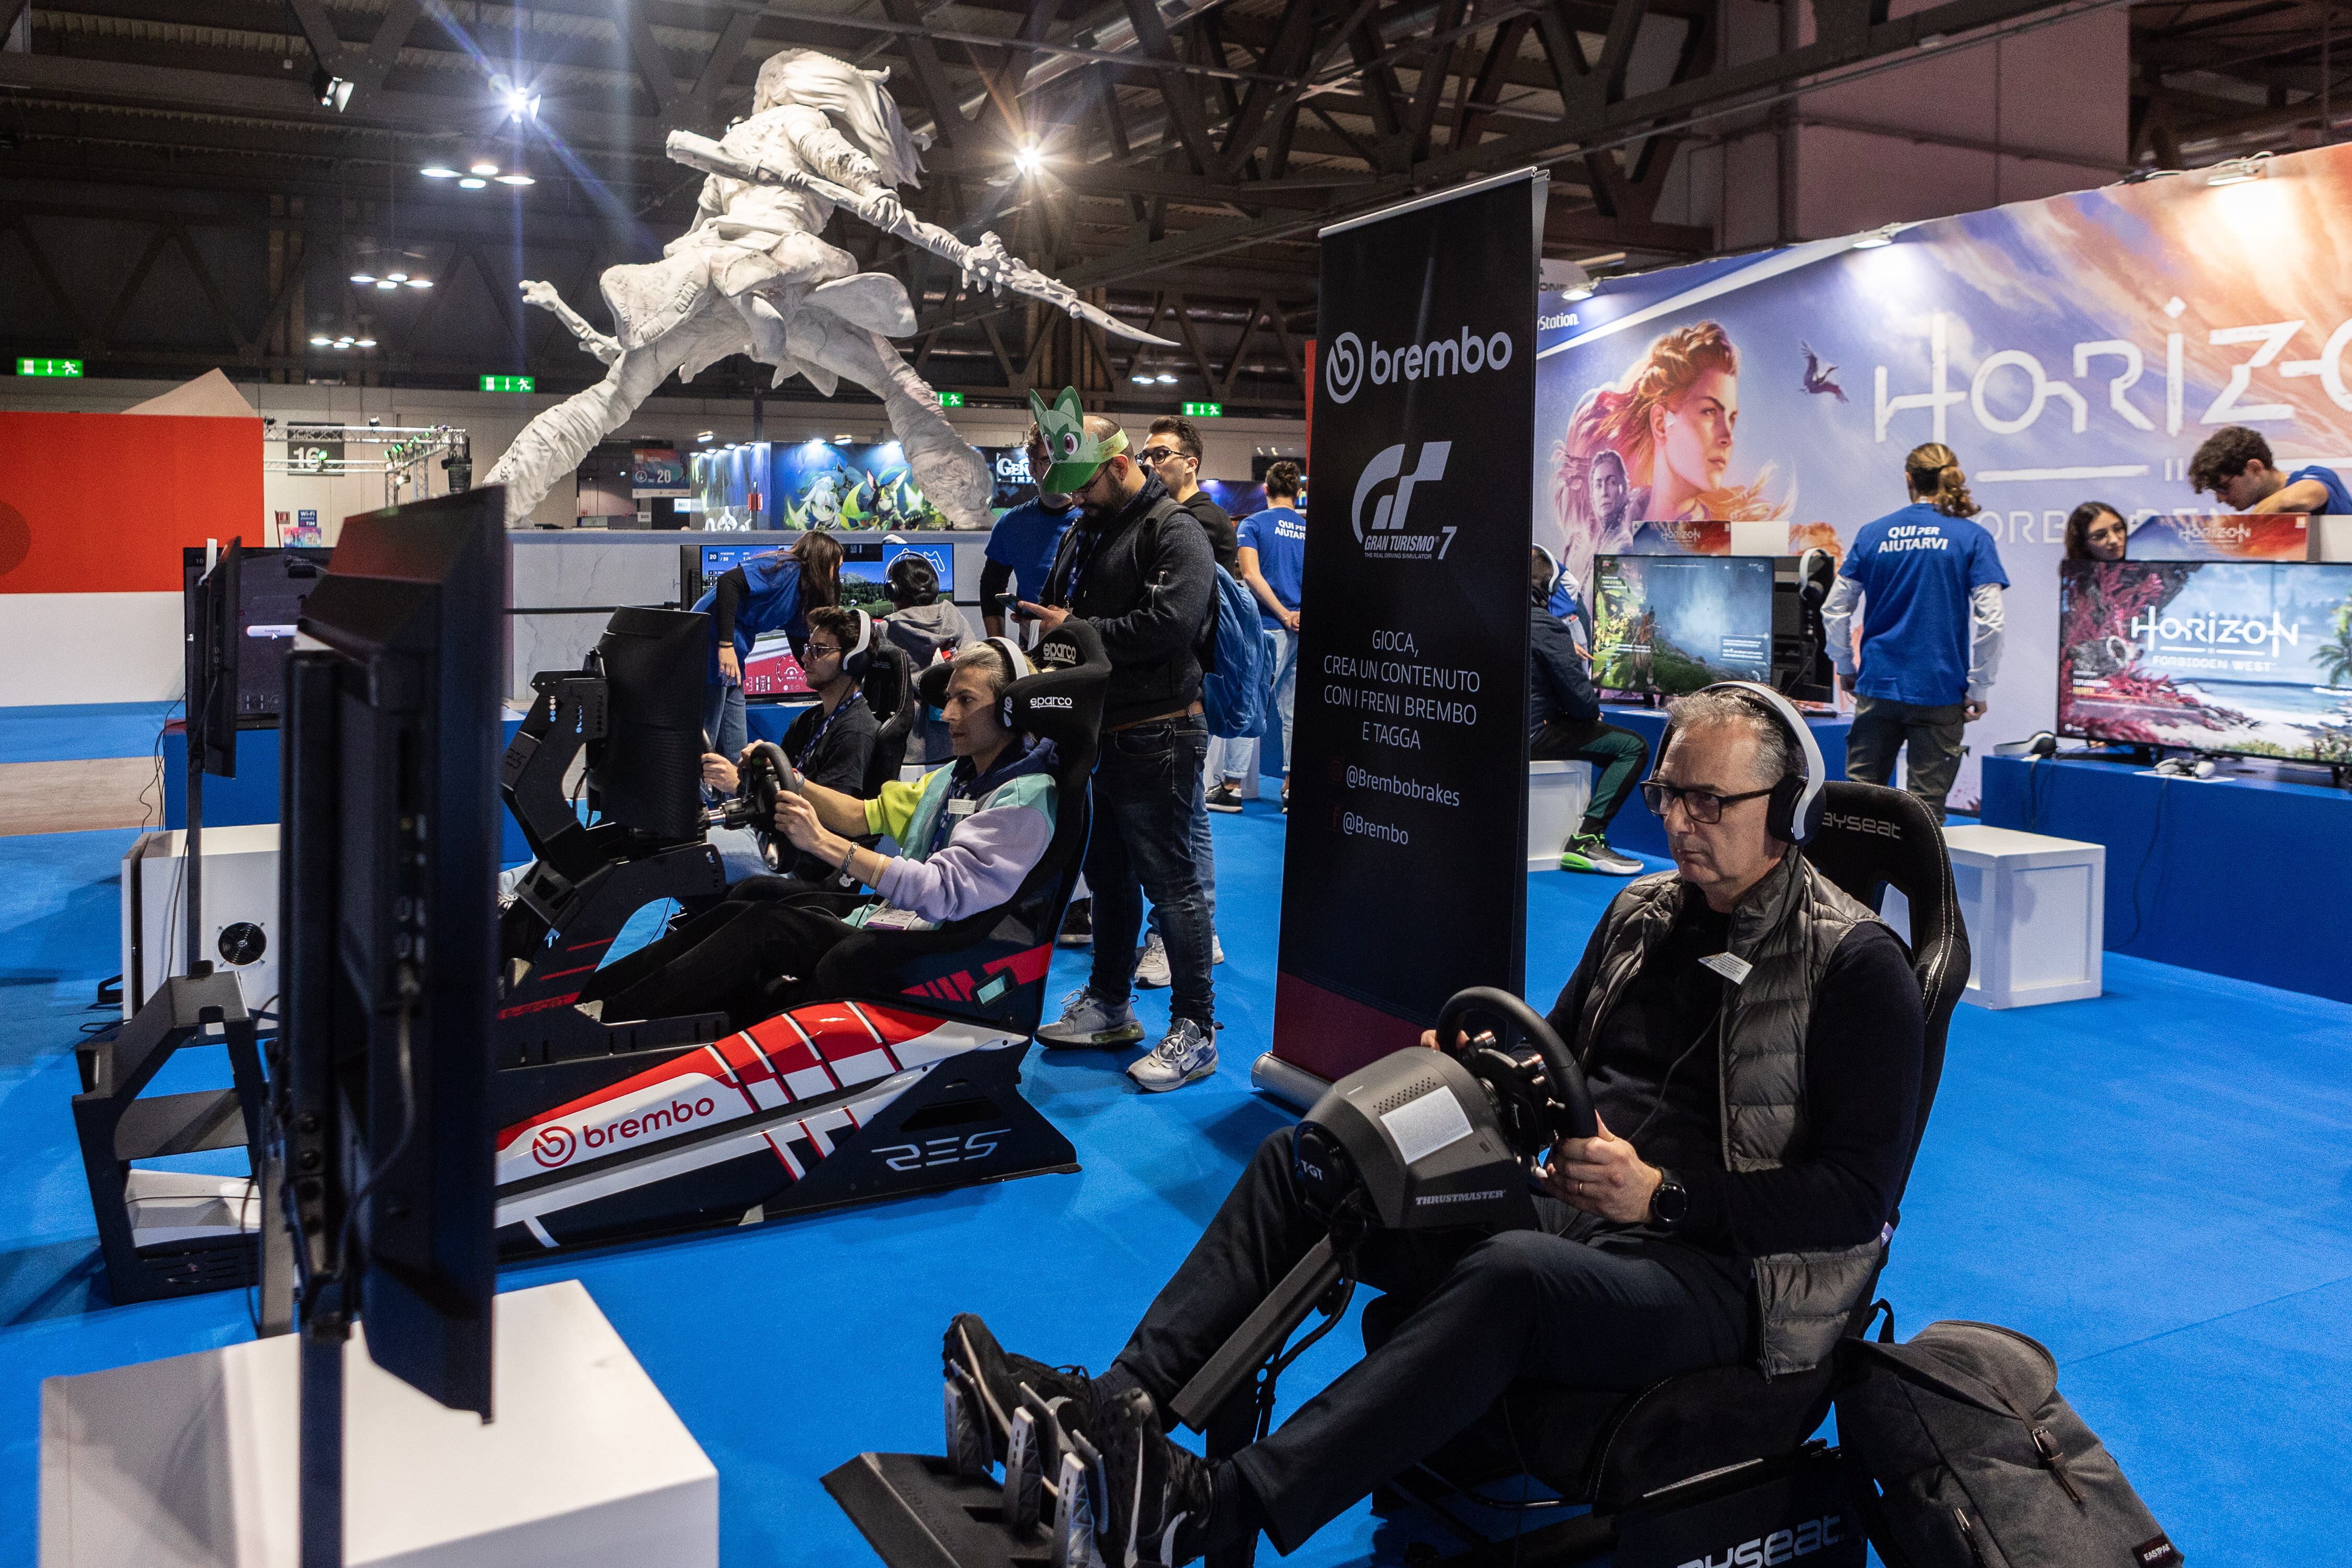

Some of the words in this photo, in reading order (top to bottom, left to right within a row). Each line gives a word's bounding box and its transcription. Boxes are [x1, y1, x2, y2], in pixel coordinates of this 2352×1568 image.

[1538, 313, 1579, 331] Station
[1370, 326, 1513, 385] brembo
[293, 446, 321, 469] 16
[996, 457, 1031, 477] GEN
[657, 470, 671, 483] 20
[1274, 526, 1306, 540] AIUTAR
[1278, 520, 1294, 529] QUI
[1887, 525, 1917, 539] QUI
[1917, 526, 1941, 536] PER
[2178, 523, 2252, 544] HORIZON
[1364, 535, 1389, 551] GRAN
[1438, 526, 1458, 560] 7
[1877, 537, 1949, 554] AIUTARVI
[2131, 605, 2299, 658] HORIZON
[1043, 642, 1076, 662] sparco
[1372, 629, 1419, 657] GIOCA,
[1324, 655, 1357, 677] CREA
[1360, 660, 1377, 681] UN
[1380, 662, 1480, 693] CONTENUTO
[2152, 655, 2229, 670] FORBIDDEN
[2231, 660, 2272, 672] WEST
[1030, 696, 1073, 709] sparco
[1324, 685, 1351, 707] CON
[1361, 690, 1399, 716] FRENI
[1405, 697, 1477, 725] BREMBO
[1363, 722, 1369, 740] E
[1373, 723, 1421, 750] TAGGA
[1346, 765, 1460, 807] @Brembobrakes
[1343, 811, 1409, 845] @Brembo
[1821, 812, 1901, 840] ayseat
[582, 1097, 715, 1148] brembo
[1300, 1159, 1323, 1181] T-GT
[1415, 1190, 1505, 1205] THRUSTMASTER
